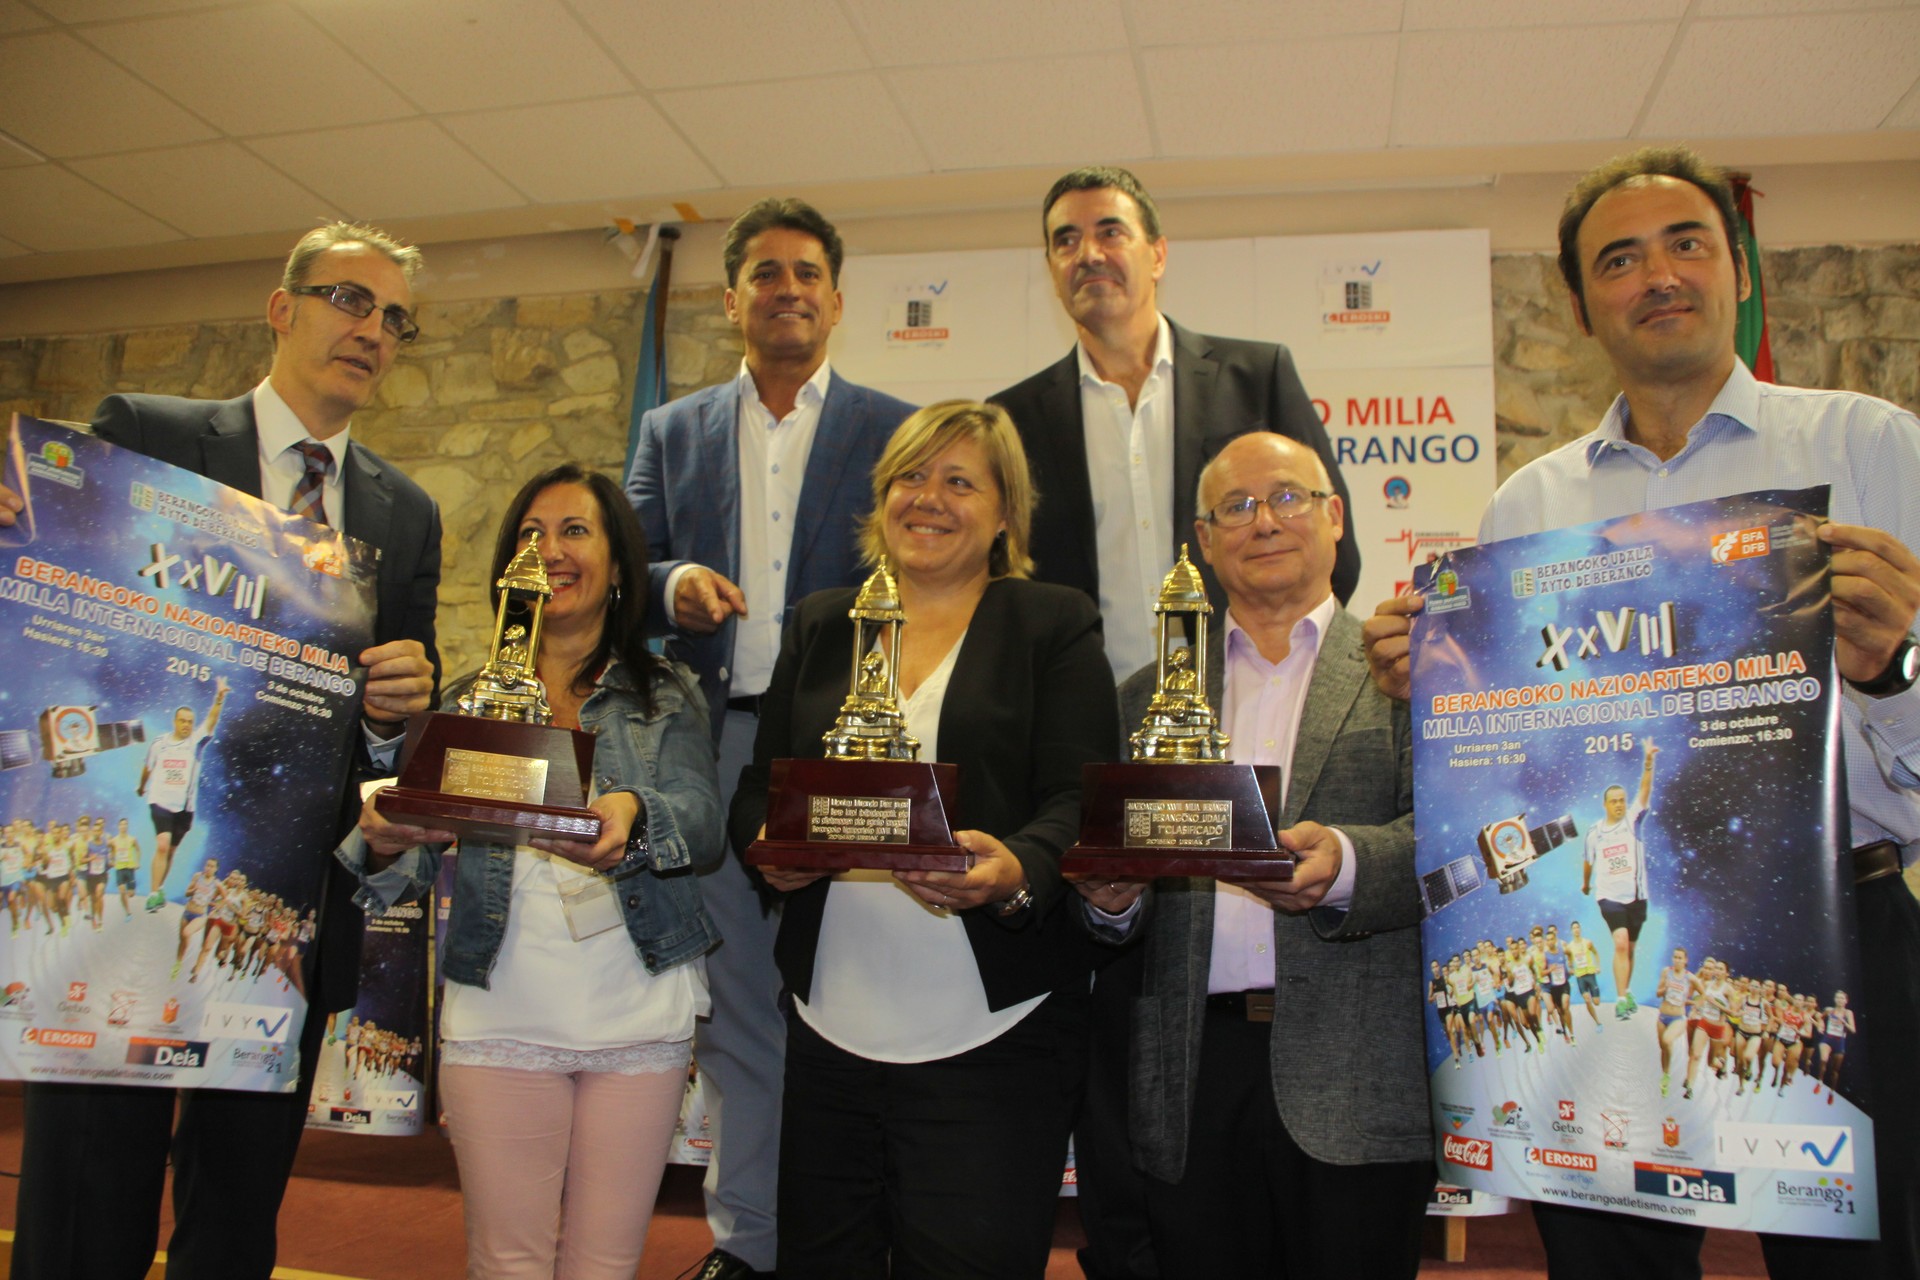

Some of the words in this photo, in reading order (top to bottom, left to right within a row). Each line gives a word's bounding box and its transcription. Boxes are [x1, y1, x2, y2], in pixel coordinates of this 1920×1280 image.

[1347, 396, 1455, 427] MILIA
[1337, 434, 1480, 465] RANGO
[158, 505, 191, 524] AYTO.
[192, 516, 208, 530] DE
[208, 522, 258, 548] BERANGO
[1741, 531, 1765, 543] BFA
[1742, 542, 1767, 555] DFB
[1536, 555, 1609, 579] BERANGOKO
[1610, 546, 1653, 566] UDALA
[1540, 578, 1575, 594] AYTO.
[1576, 574, 1591, 588] DE
[1593, 563, 1652, 585] BERANGO
[15, 556, 161, 615] BERANGOKO
[163, 603, 300, 658] NAZIOARTEKO
[301, 644, 350, 675] MILIA
[0, 577, 70, 615] MILLA
[72, 598, 237, 663] INTERNACIONAL
[240, 647, 269, 672] DE
[268, 656, 356, 697] BERANGO
[166, 656, 212, 682] 2015
[275, 683, 289, 695] de
[288, 686, 326, 705] octubre
[1432, 681, 1566, 716] BERANGOKO
[1570, 661, 1733, 701] NAZIOARTEKO
[1735, 650, 1806, 681] MILIA
[1423, 714, 1483, 740] MILLA
[1486, 697, 1659, 736] INTERNACIONAL
[1663, 691, 1695, 717] DE
[1697, 676, 1821, 713] BERANGO
[1699, 720, 1708, 732] 3
[1709, 718, 1727, 731] de
[1728, 714, 1779, 729] octubre
[1454, 742, 1499, 755] Urriaren
[1501, 740, 1521, 751] 3an
[1584, 732, 1633, 755] 2015
[1688, 734, 1754, 749] Comienzo:
[1755, 728, 1793, 742] 16:30
[1450, 755, 1494, 768] Hasiera:
[1496, 752, 1527, 765] 16:30
[1152, 813, 1200, 822] BERANGOKO
[1201, 814, 1227, 823] UDALA
[1165, 825, 1224, 835] CLASIFICADO
[1608, 855, 1628, 871] 396
[43, 1031, 94, 1045] EROSKI
[154, 1045, 200, 1067] Deia
[343, 1112, 368, 1123] Deia
[1551, 1120, 1584, 1135] Getxo
[1545, 1152, 1594, 1169] EROSKI
[1438, 1191, 1469, 1204] Deia
[1667, 1174, 1727, 1202] Deia
[1777, 1180, 1844, 1202] Berango
[1542, 1186, 1697, 1217] www.berangoatletismo.com
[1833, 1200, 1856, 1214] 21
